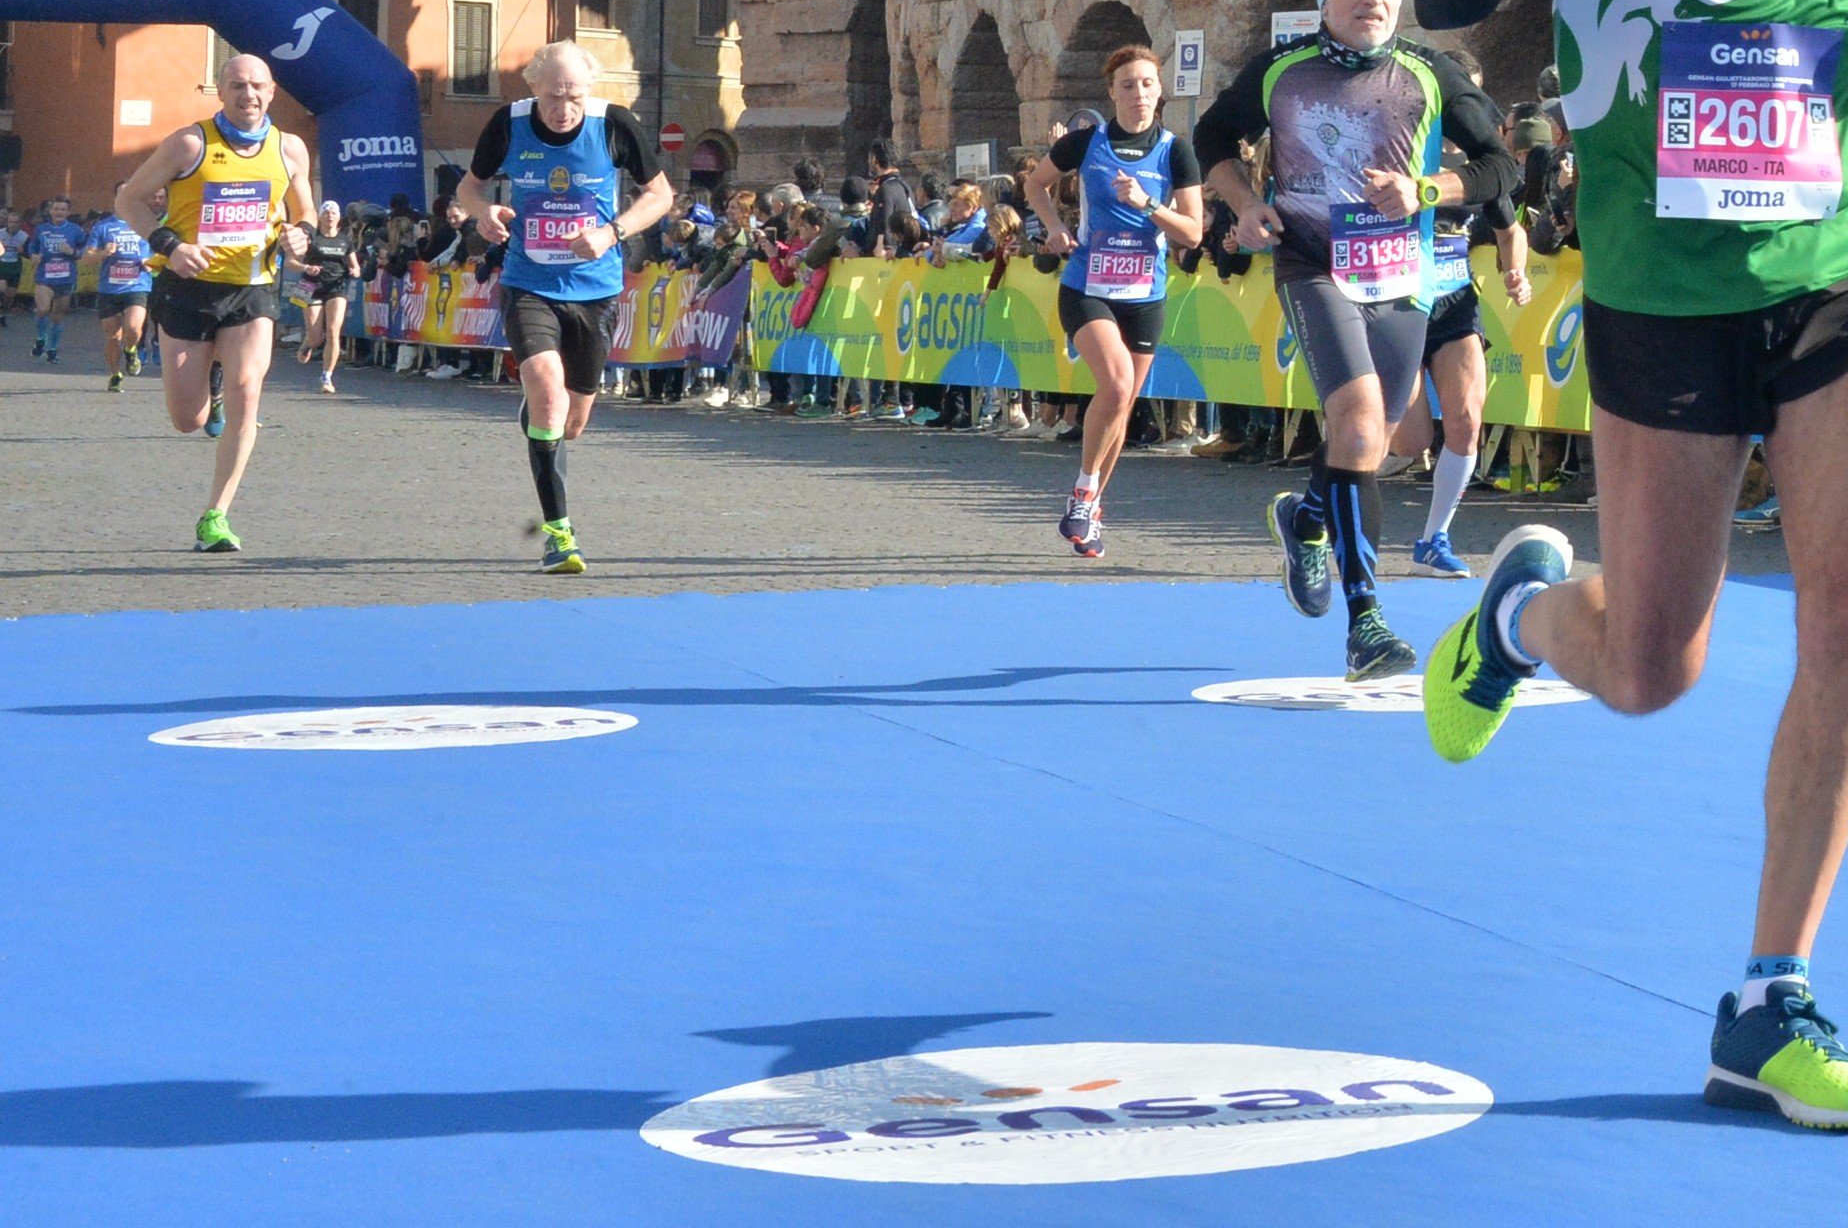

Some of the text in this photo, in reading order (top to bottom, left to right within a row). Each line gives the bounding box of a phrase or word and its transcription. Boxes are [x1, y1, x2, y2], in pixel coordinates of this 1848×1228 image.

[1710, 43, 1800, 68] Gensan
[1699, 97, 1805, 150] 2607
[1693, 158, 1748, 174] MARCO
[1764, 160, 1785, 176] ITA
[220, 187, 256, 196] Gensan
[216, 205, 256, 224] 1988
[542, 200, 581, 211] Gensan
[1107, 237, 1142, 246] Gensan
[1433, 244, 1454, 253] nsan
[1353, 236, 1406, 267] 3133
[1102, 255, 1140, 274] F1231
[1773, 961, 1806, 975] SP
[693, 1079, 1454, 1151] Gensan
[796, 1142, 943, 1156] SPORT
